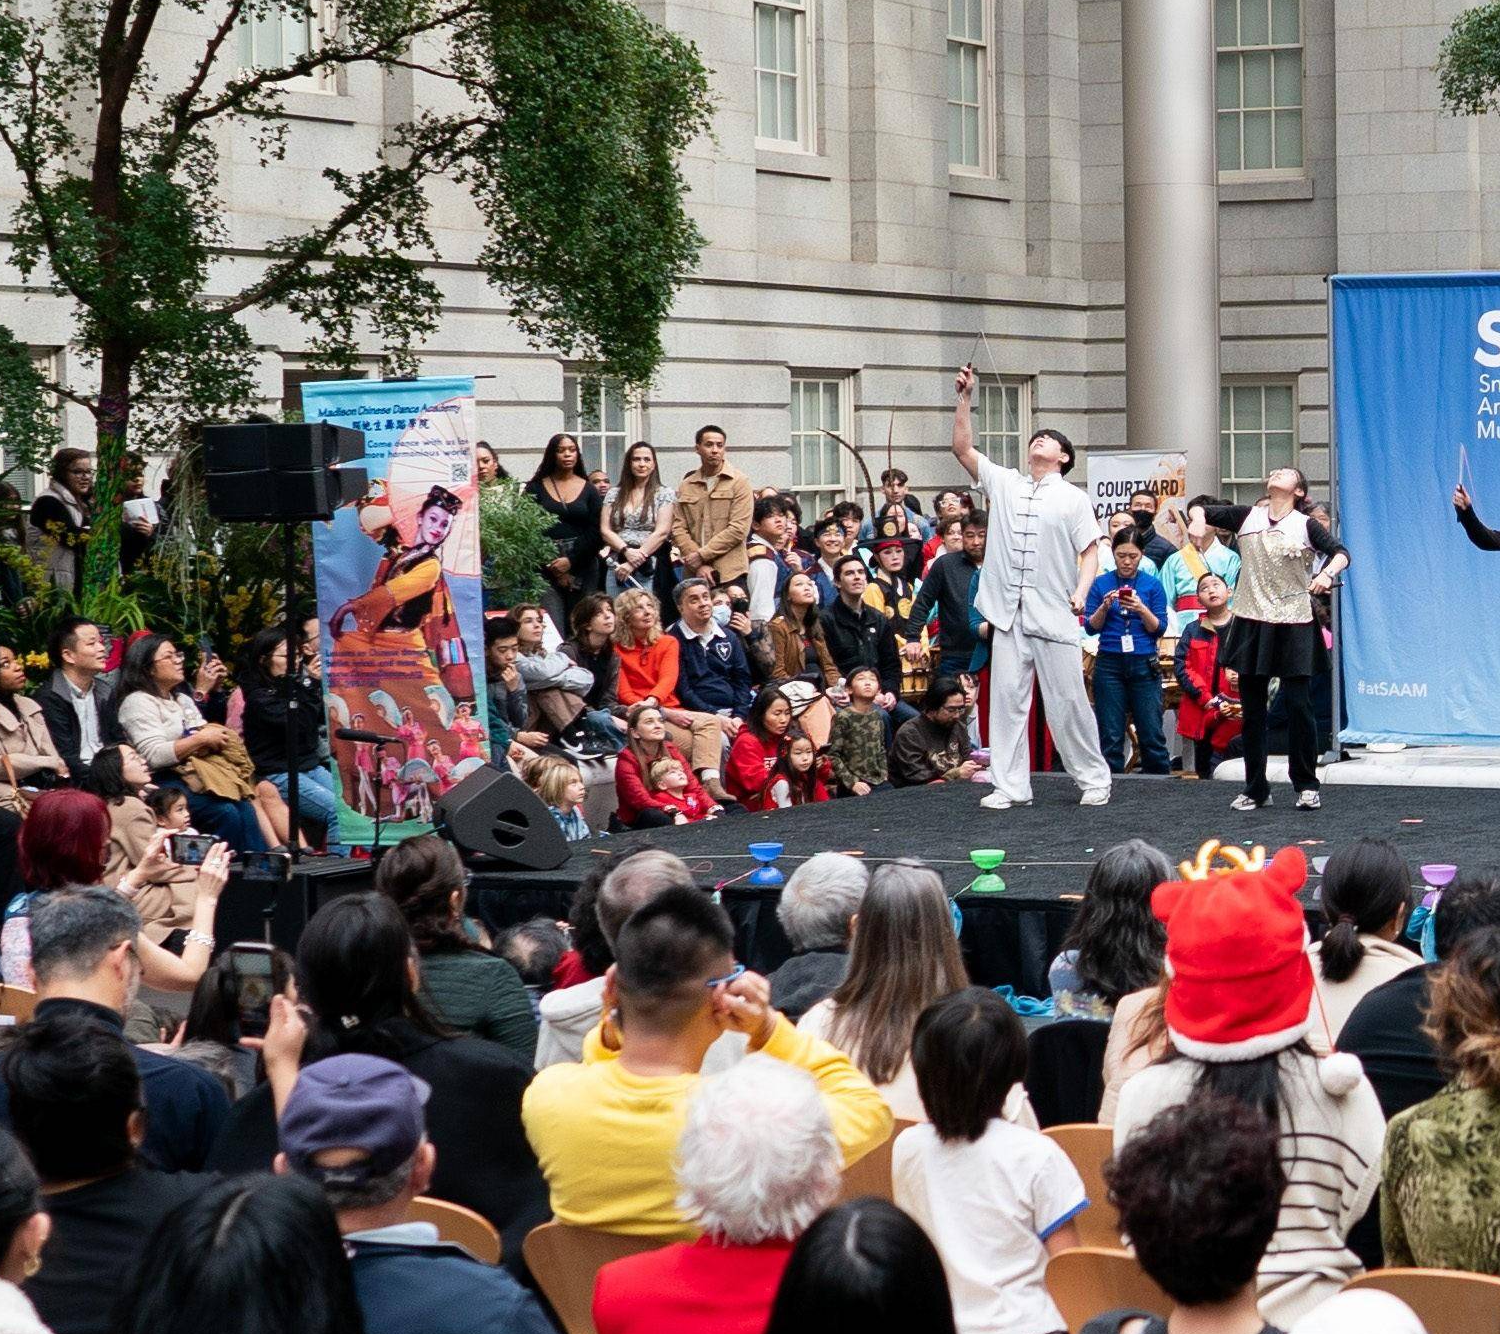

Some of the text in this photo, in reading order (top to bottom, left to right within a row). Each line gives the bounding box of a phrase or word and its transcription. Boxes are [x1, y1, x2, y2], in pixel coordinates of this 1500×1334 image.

[318, 403, 461, 417] Madison Chinese Dance Academy
[1097, 479, 1179, 498] COURTYARD
[1357, 680, 1428, 698] #atSAAM
